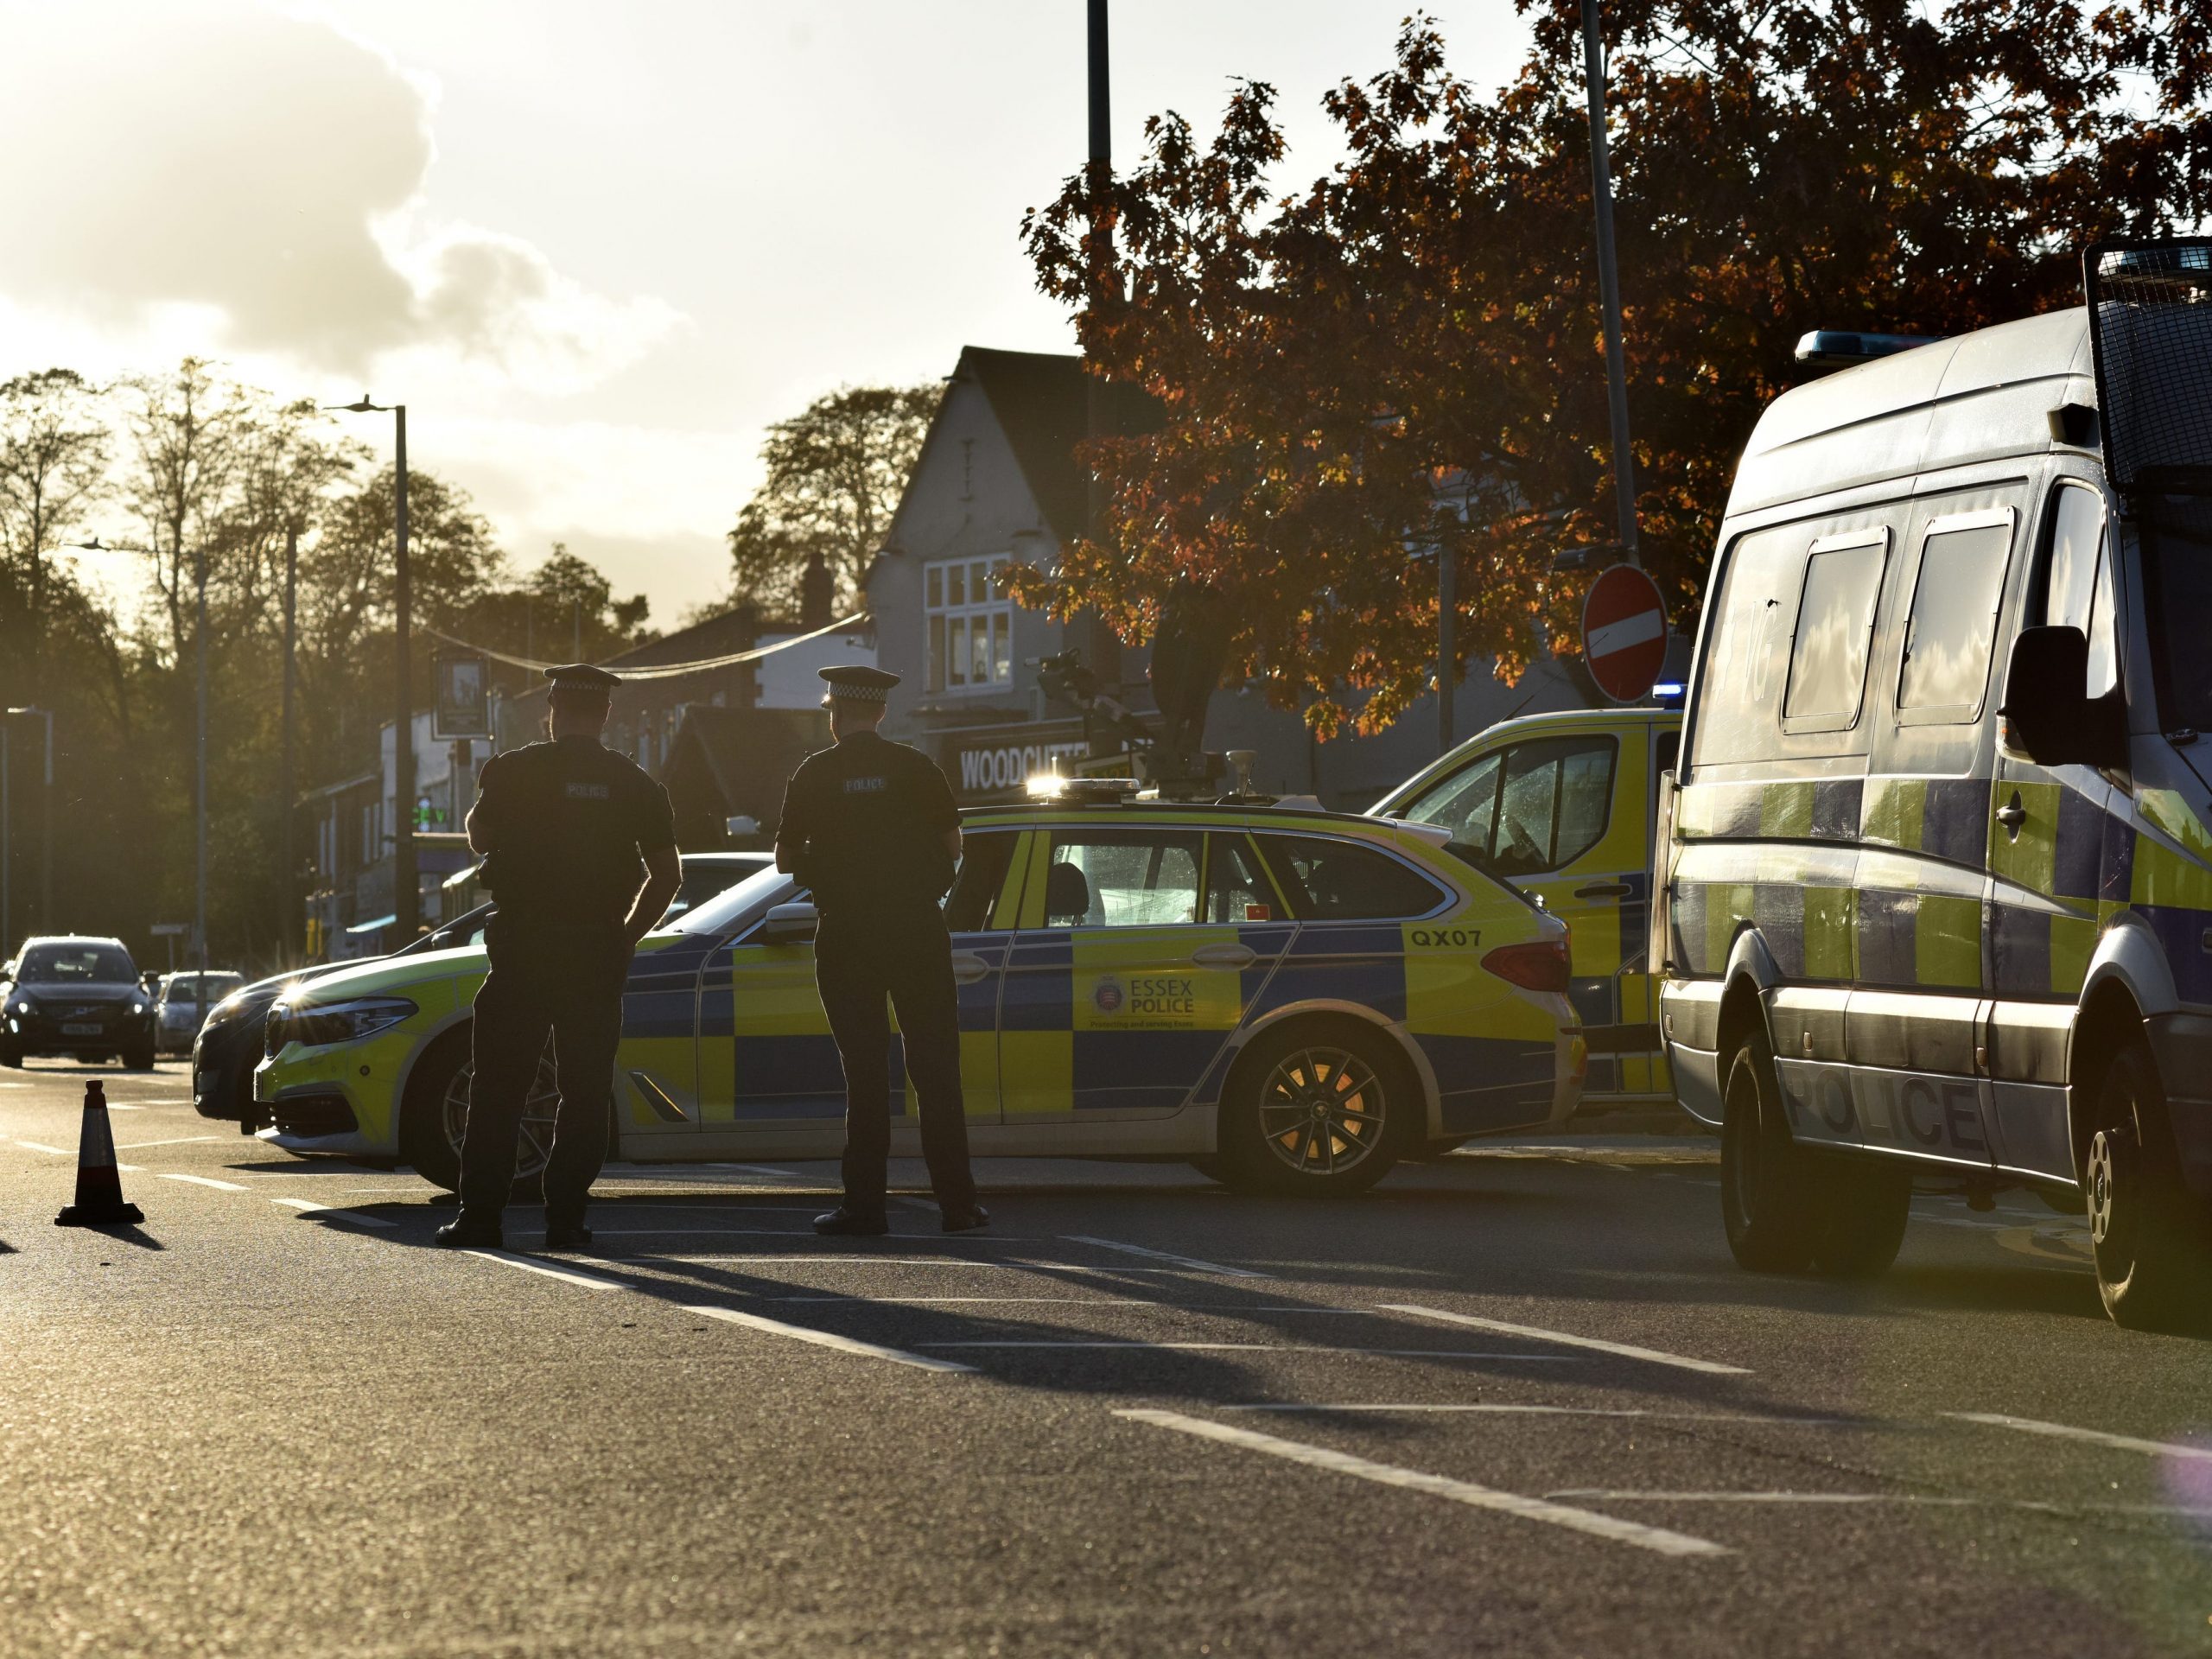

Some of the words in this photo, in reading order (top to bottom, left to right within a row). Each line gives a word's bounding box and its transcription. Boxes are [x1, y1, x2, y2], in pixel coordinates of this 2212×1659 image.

[567, 784, 609, 798] POLICE
[846, 779, 886, 791] POLICE
[1411, 930, 1482, 947] QX07
[1130, 979, 1192, 997] ESSEX
[1131, 998, 1194, 1014] POLICE
[1090, 1020, 1128, 1029] Protecting
[1783, 1066, 1986, 1153] POLICE
